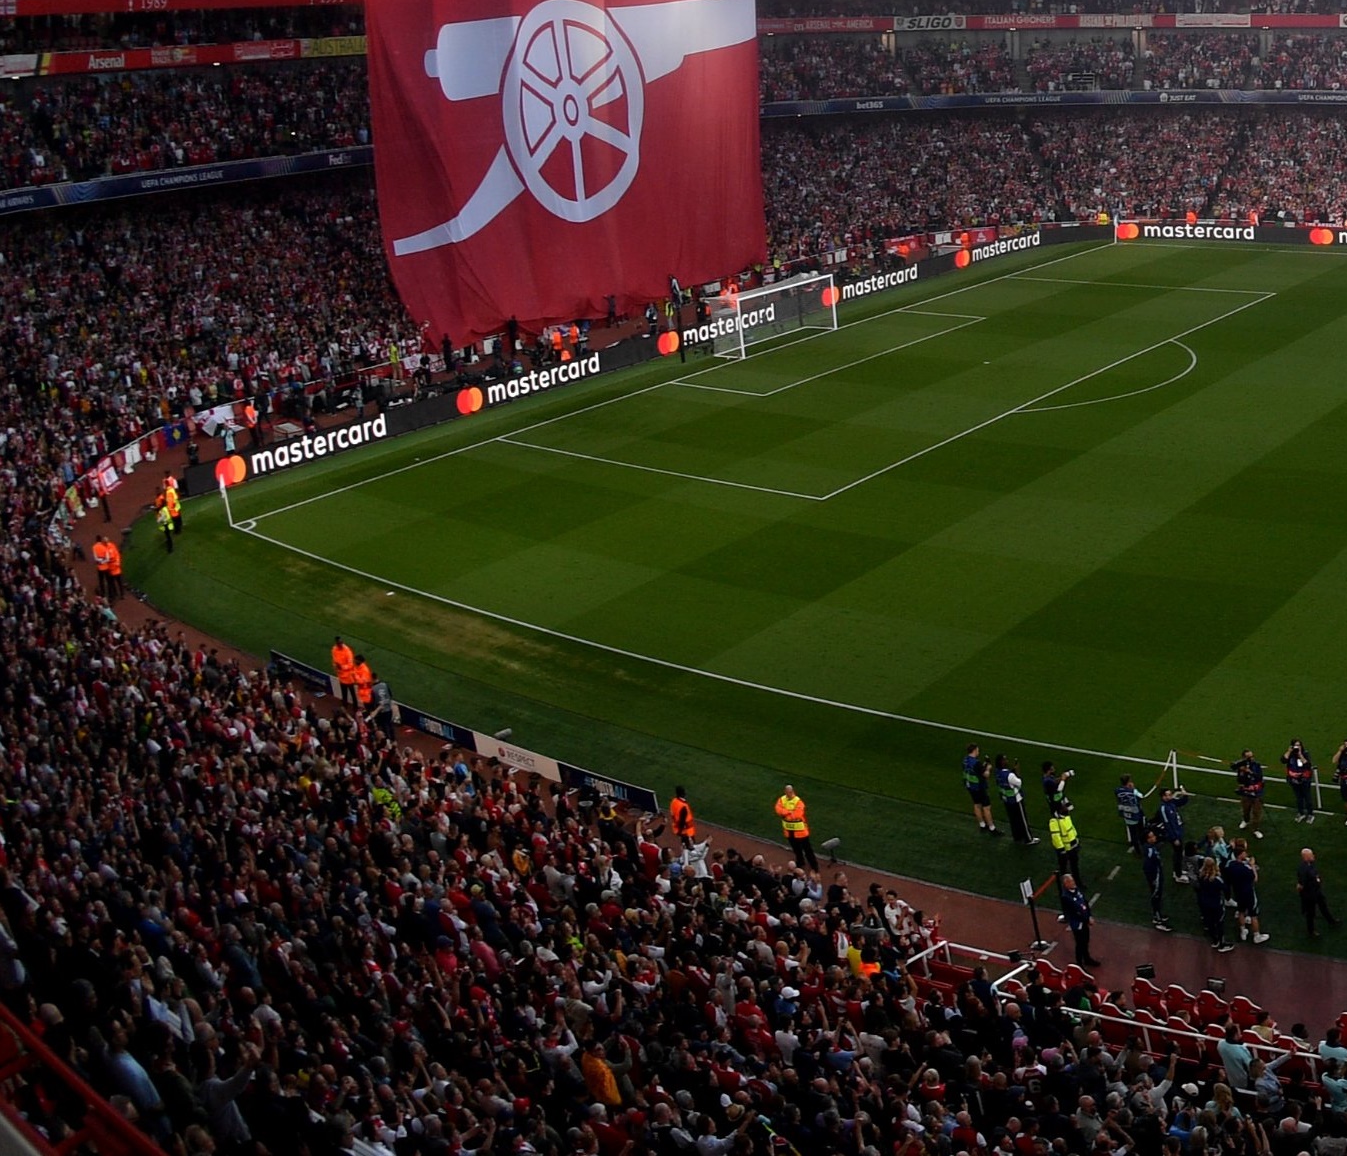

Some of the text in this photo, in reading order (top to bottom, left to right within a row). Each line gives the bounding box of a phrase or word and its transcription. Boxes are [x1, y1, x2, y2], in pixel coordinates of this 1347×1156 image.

[845, 19, 874, 29] AMERICA
[906, 18, 952, 29] SLIGO
[984, 16, 1013, 25] ITALIAN
[88, 51, 125, 70] Arsenal
[856, 101, 884, 110] bet365
[1002, 96, 1036, 104] CHAMPIONS
[1316, 94, 1347, 102] CHAMPIONS
[141, 170, 224, 188] UEFA CHAMPIONS LEAGUE
[1144, 223, 1255, 240] mastercard
[972, 230, 1040, 262] mastercard
[842, 262, 918, 300] mastercard
[487, 352, 600, 404] mastercard
[251, 412, 387, 474] mastercard
